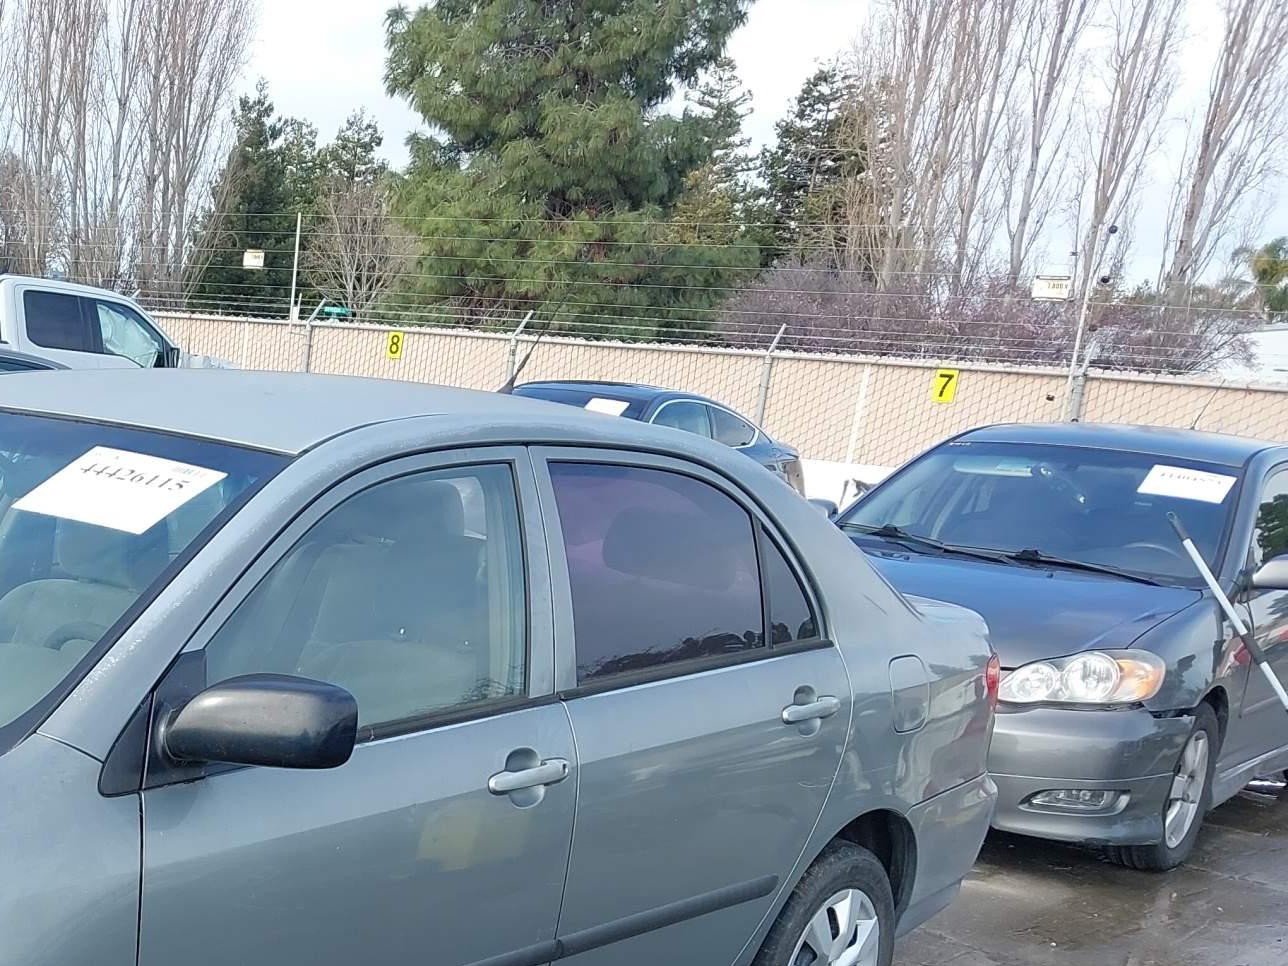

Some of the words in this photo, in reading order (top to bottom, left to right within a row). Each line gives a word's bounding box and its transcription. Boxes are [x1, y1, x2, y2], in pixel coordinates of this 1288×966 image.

[389, 334, 400, 354] 8
[938, 373, 955, 397] 7
[80, 463, 190, 491] 44426115
